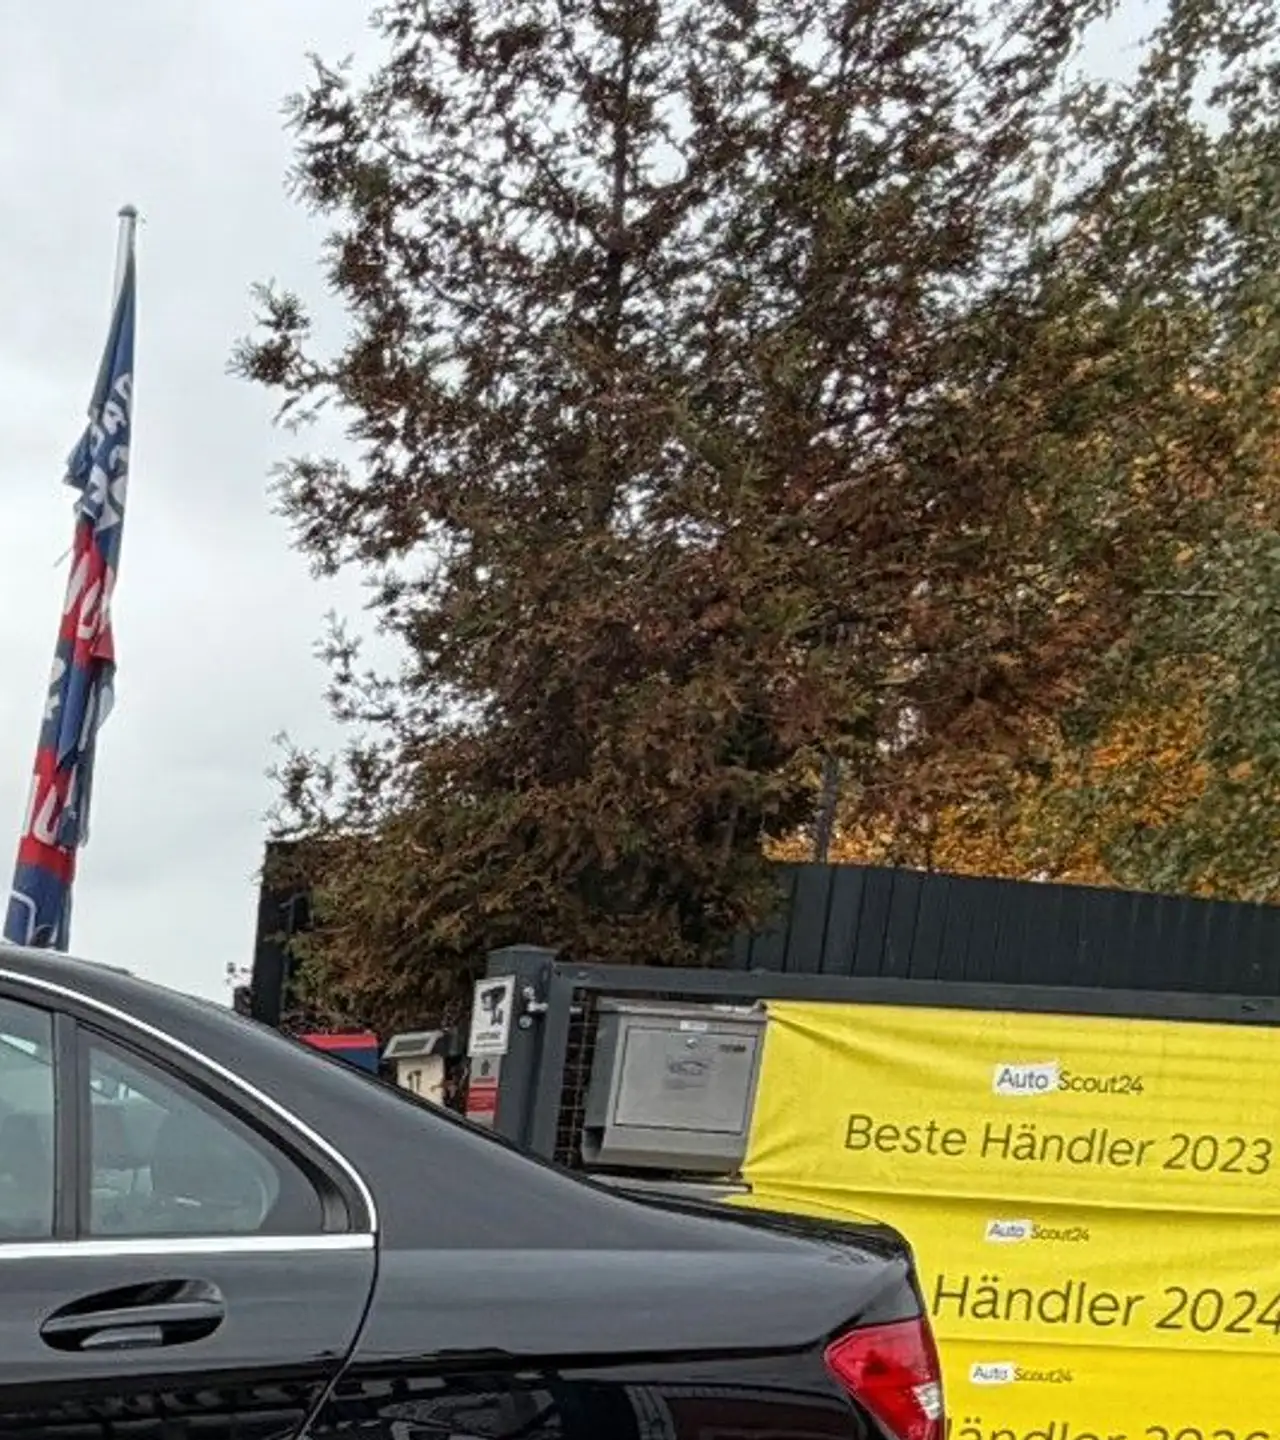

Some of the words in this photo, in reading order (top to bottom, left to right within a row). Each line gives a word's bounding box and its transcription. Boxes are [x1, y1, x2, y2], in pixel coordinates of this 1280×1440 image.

[843, 1113, 968, 1156] Beste
[979, 1121, 1155, 1168] Händler
[1162, 1132, 1273, 1175] 2023
[931, 1273, 1145, 1327] Händler
[1154, 1285, 1280, 1336] 2024
